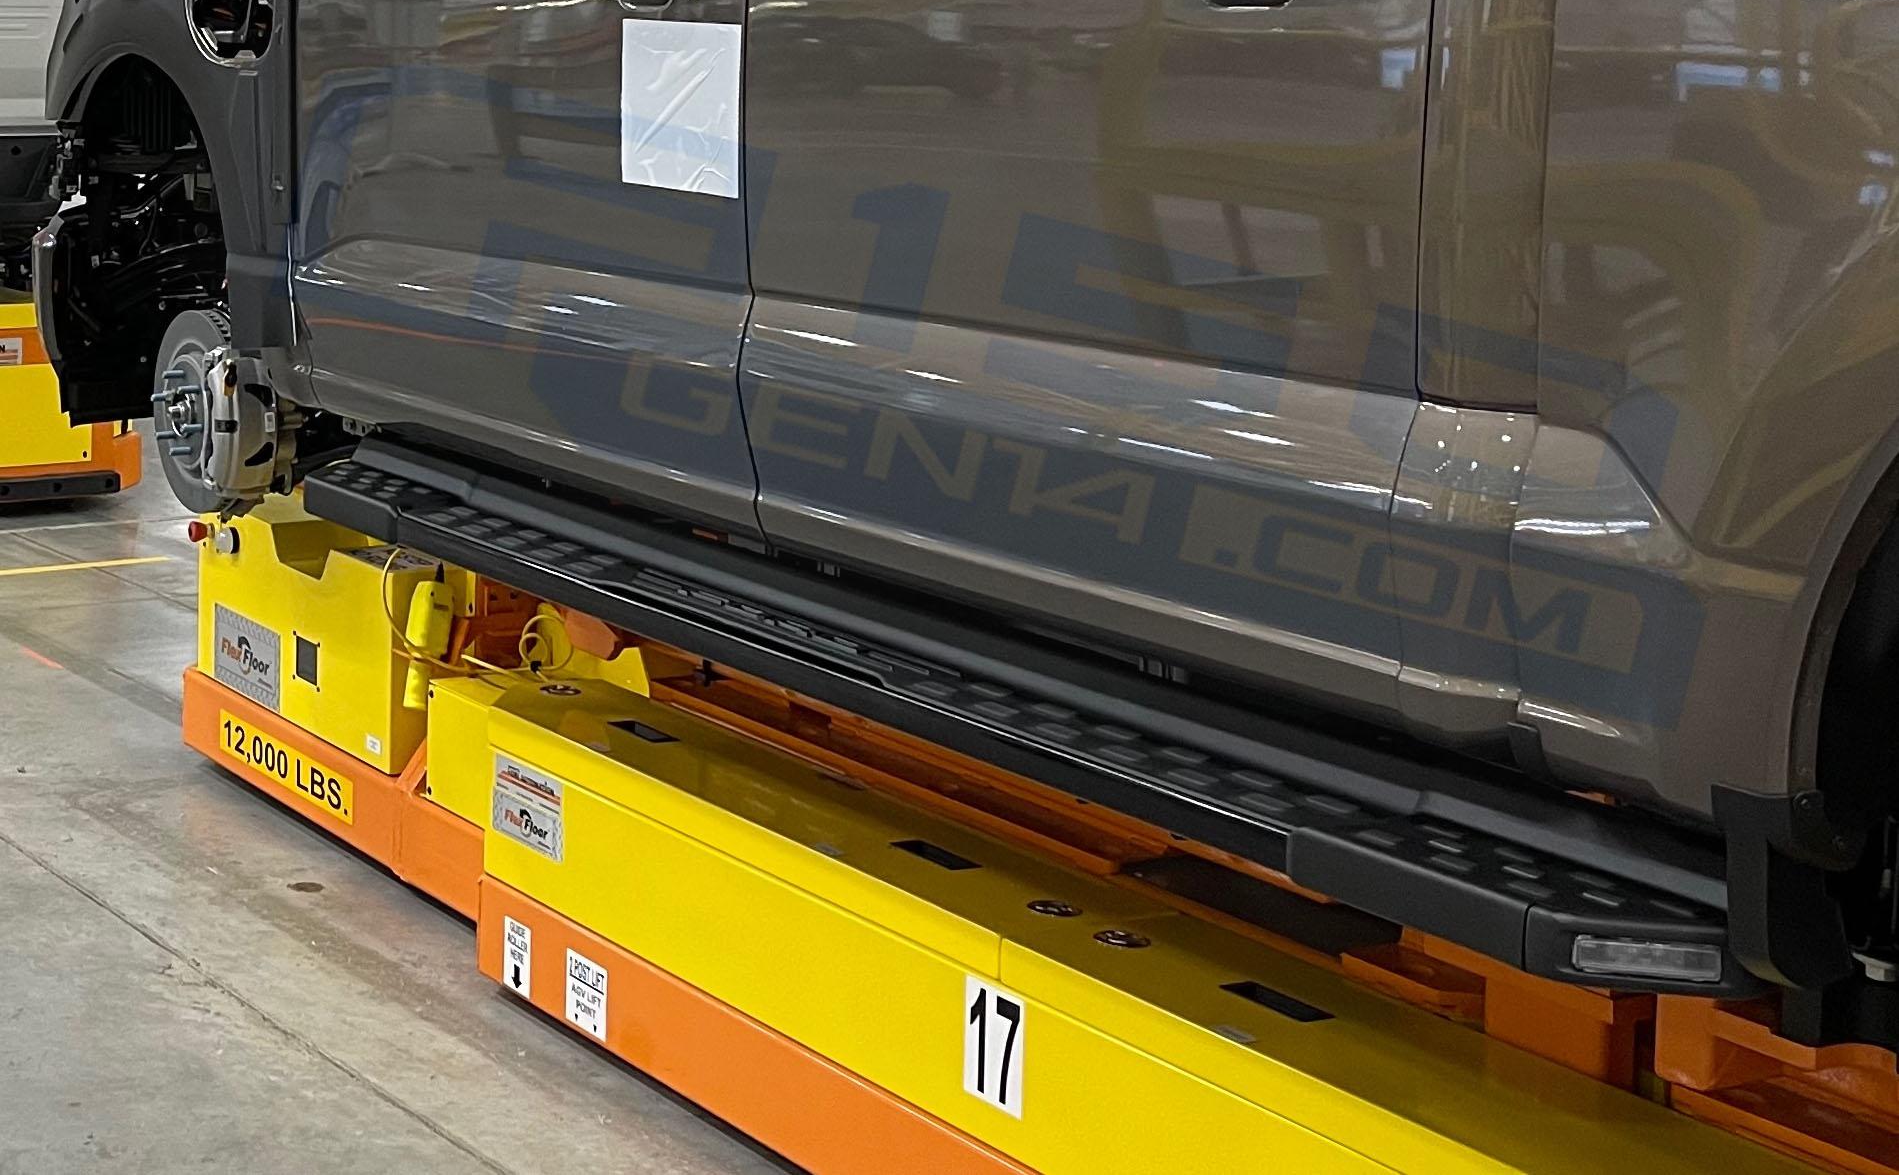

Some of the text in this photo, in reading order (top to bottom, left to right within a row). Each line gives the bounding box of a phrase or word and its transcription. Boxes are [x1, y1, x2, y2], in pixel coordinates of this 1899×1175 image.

[223, 719, 348, 816] 12,000 LBS.
[507, 932, 528, 953] ROLLER
[574, 958, 591, 982] POST
[592, 968, 605, 991] LIFT
[576, 999, 596, 1019] POINT
[587, 992, 602, 1008] LIFT
[970, 987, 1021, 1105] 17
